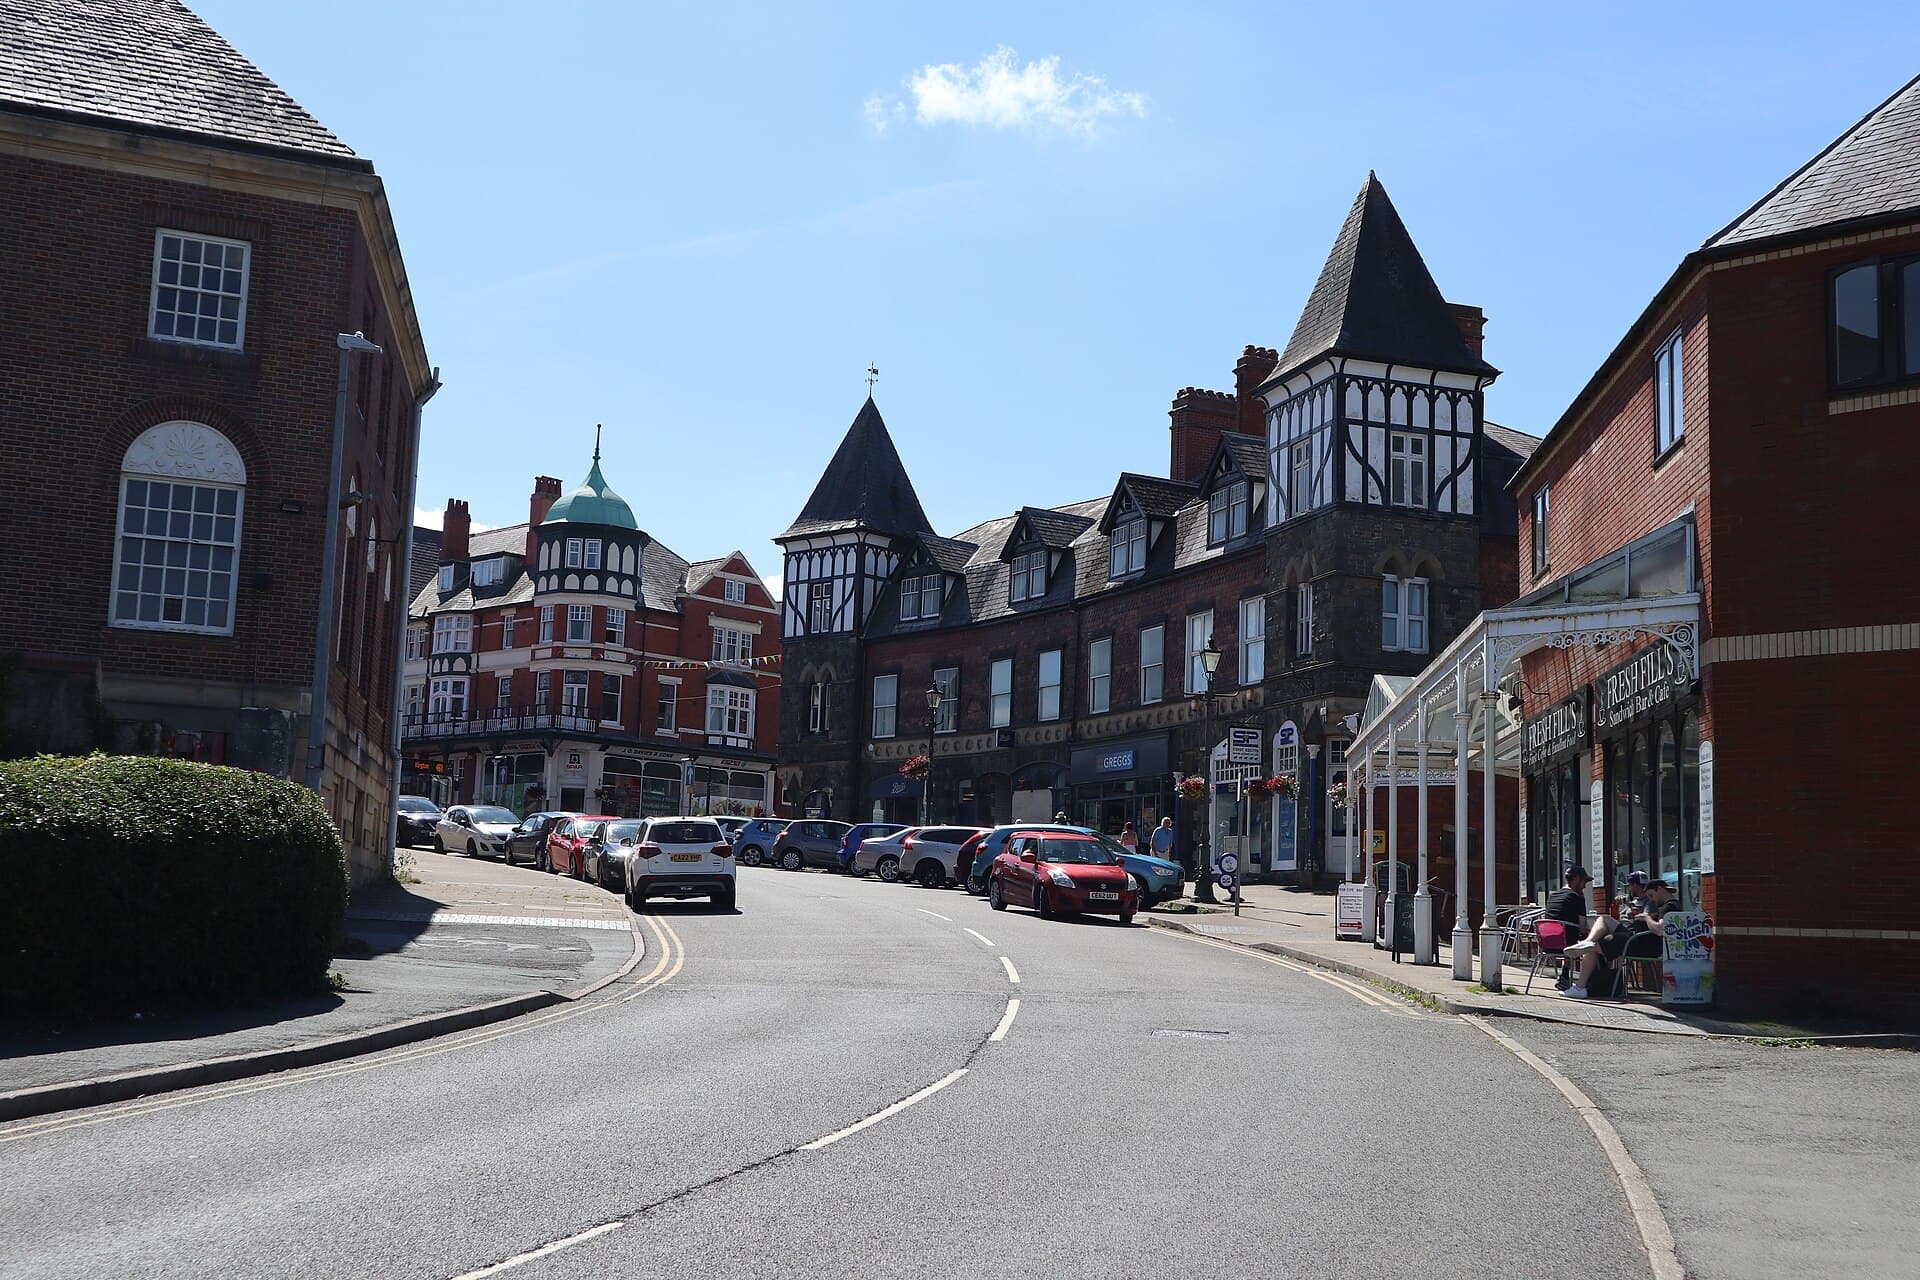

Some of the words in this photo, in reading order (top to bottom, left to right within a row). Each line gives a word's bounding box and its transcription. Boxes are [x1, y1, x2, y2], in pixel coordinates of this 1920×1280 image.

[1606, 661, 1639, 709] FRESH
[1639, 642, 1674, 691] FILL'S
[1528, 713, 1552, 752] FRESH
[1552, 701, 1577, 740] FILL'S
[1609, 699, 1635, 728] Sandwich
[1635, 695, 1648, 714] Bar
[1103, 754, 1132, 769] GREGGS
